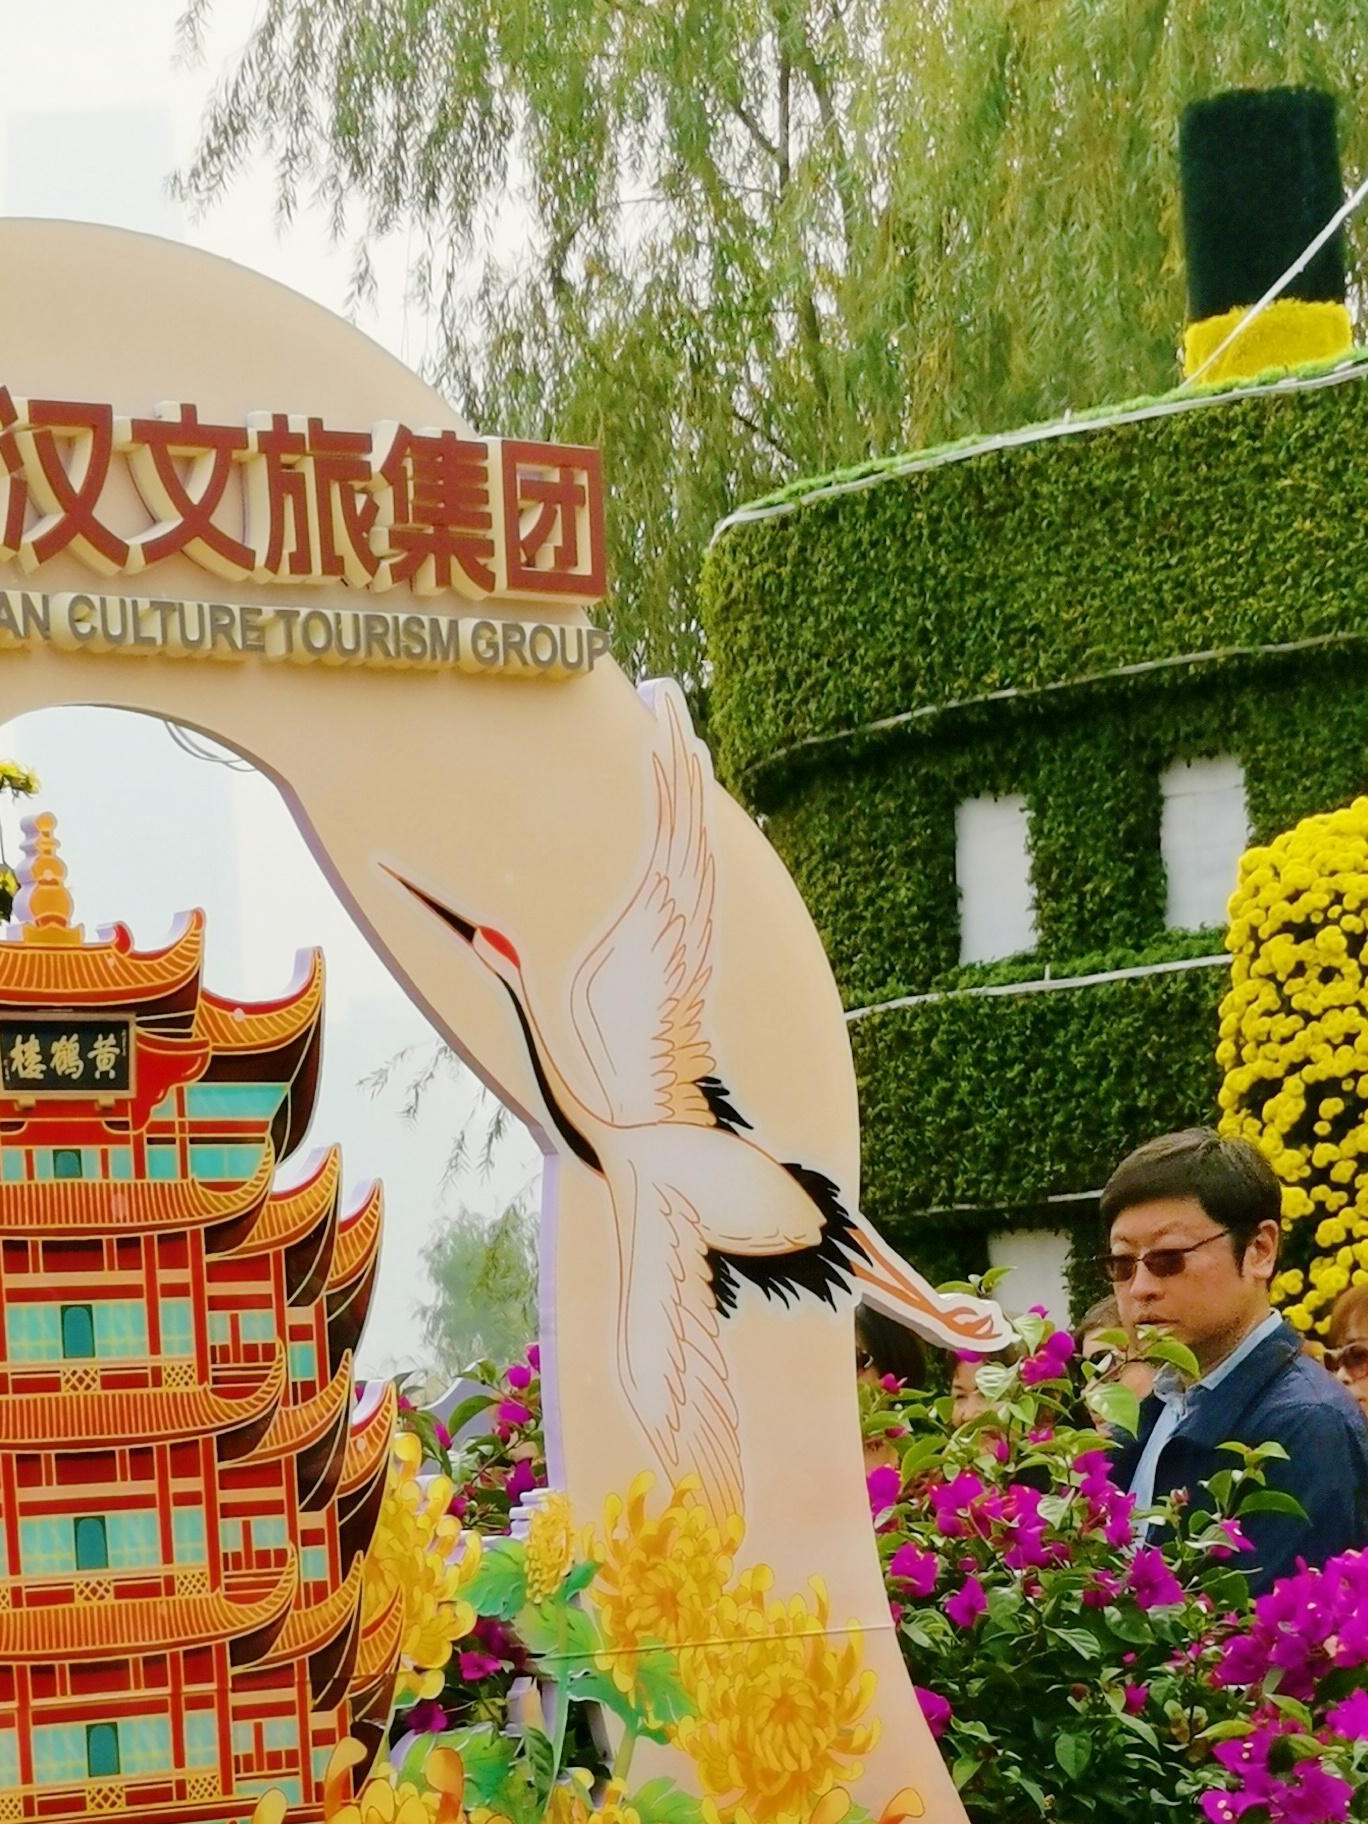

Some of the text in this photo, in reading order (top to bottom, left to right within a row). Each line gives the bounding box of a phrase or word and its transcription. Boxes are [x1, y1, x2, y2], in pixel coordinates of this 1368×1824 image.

[68, 594, 265, 653] CULTURE
[277, 608, 461, 664] TOURISM
[472, 620, 612, 672] GROUP
